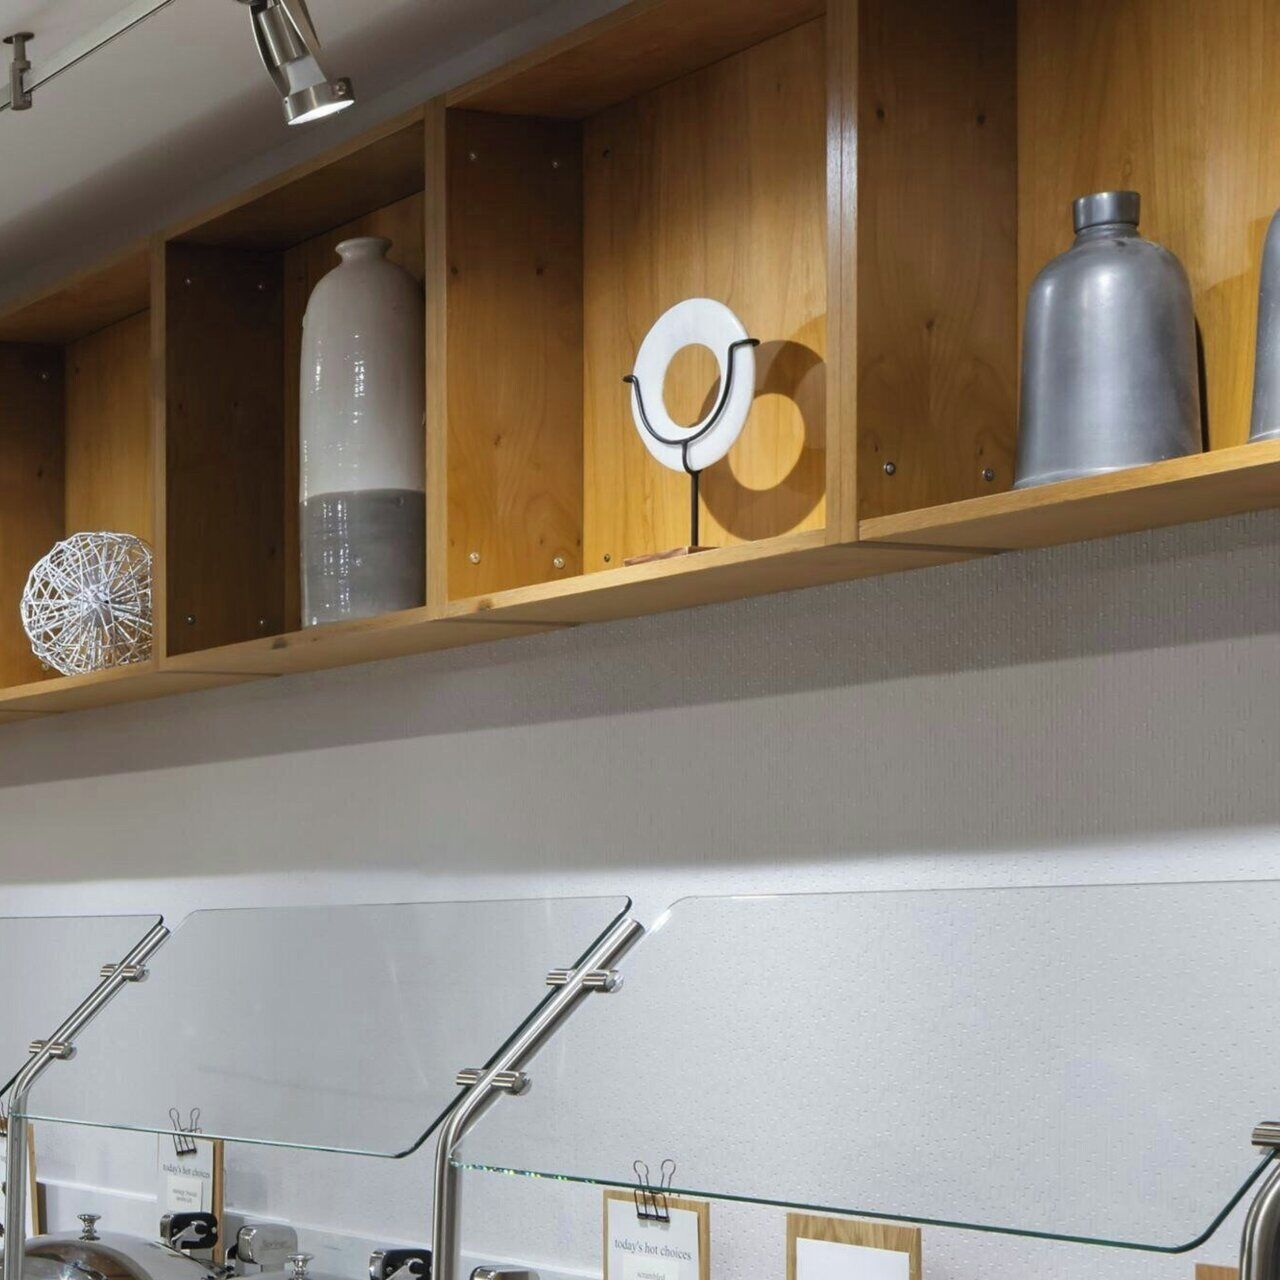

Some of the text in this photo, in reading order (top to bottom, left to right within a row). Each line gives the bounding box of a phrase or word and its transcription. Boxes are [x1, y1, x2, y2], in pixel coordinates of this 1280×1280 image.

[614, 1238, 692, 1261] today's hot choices
